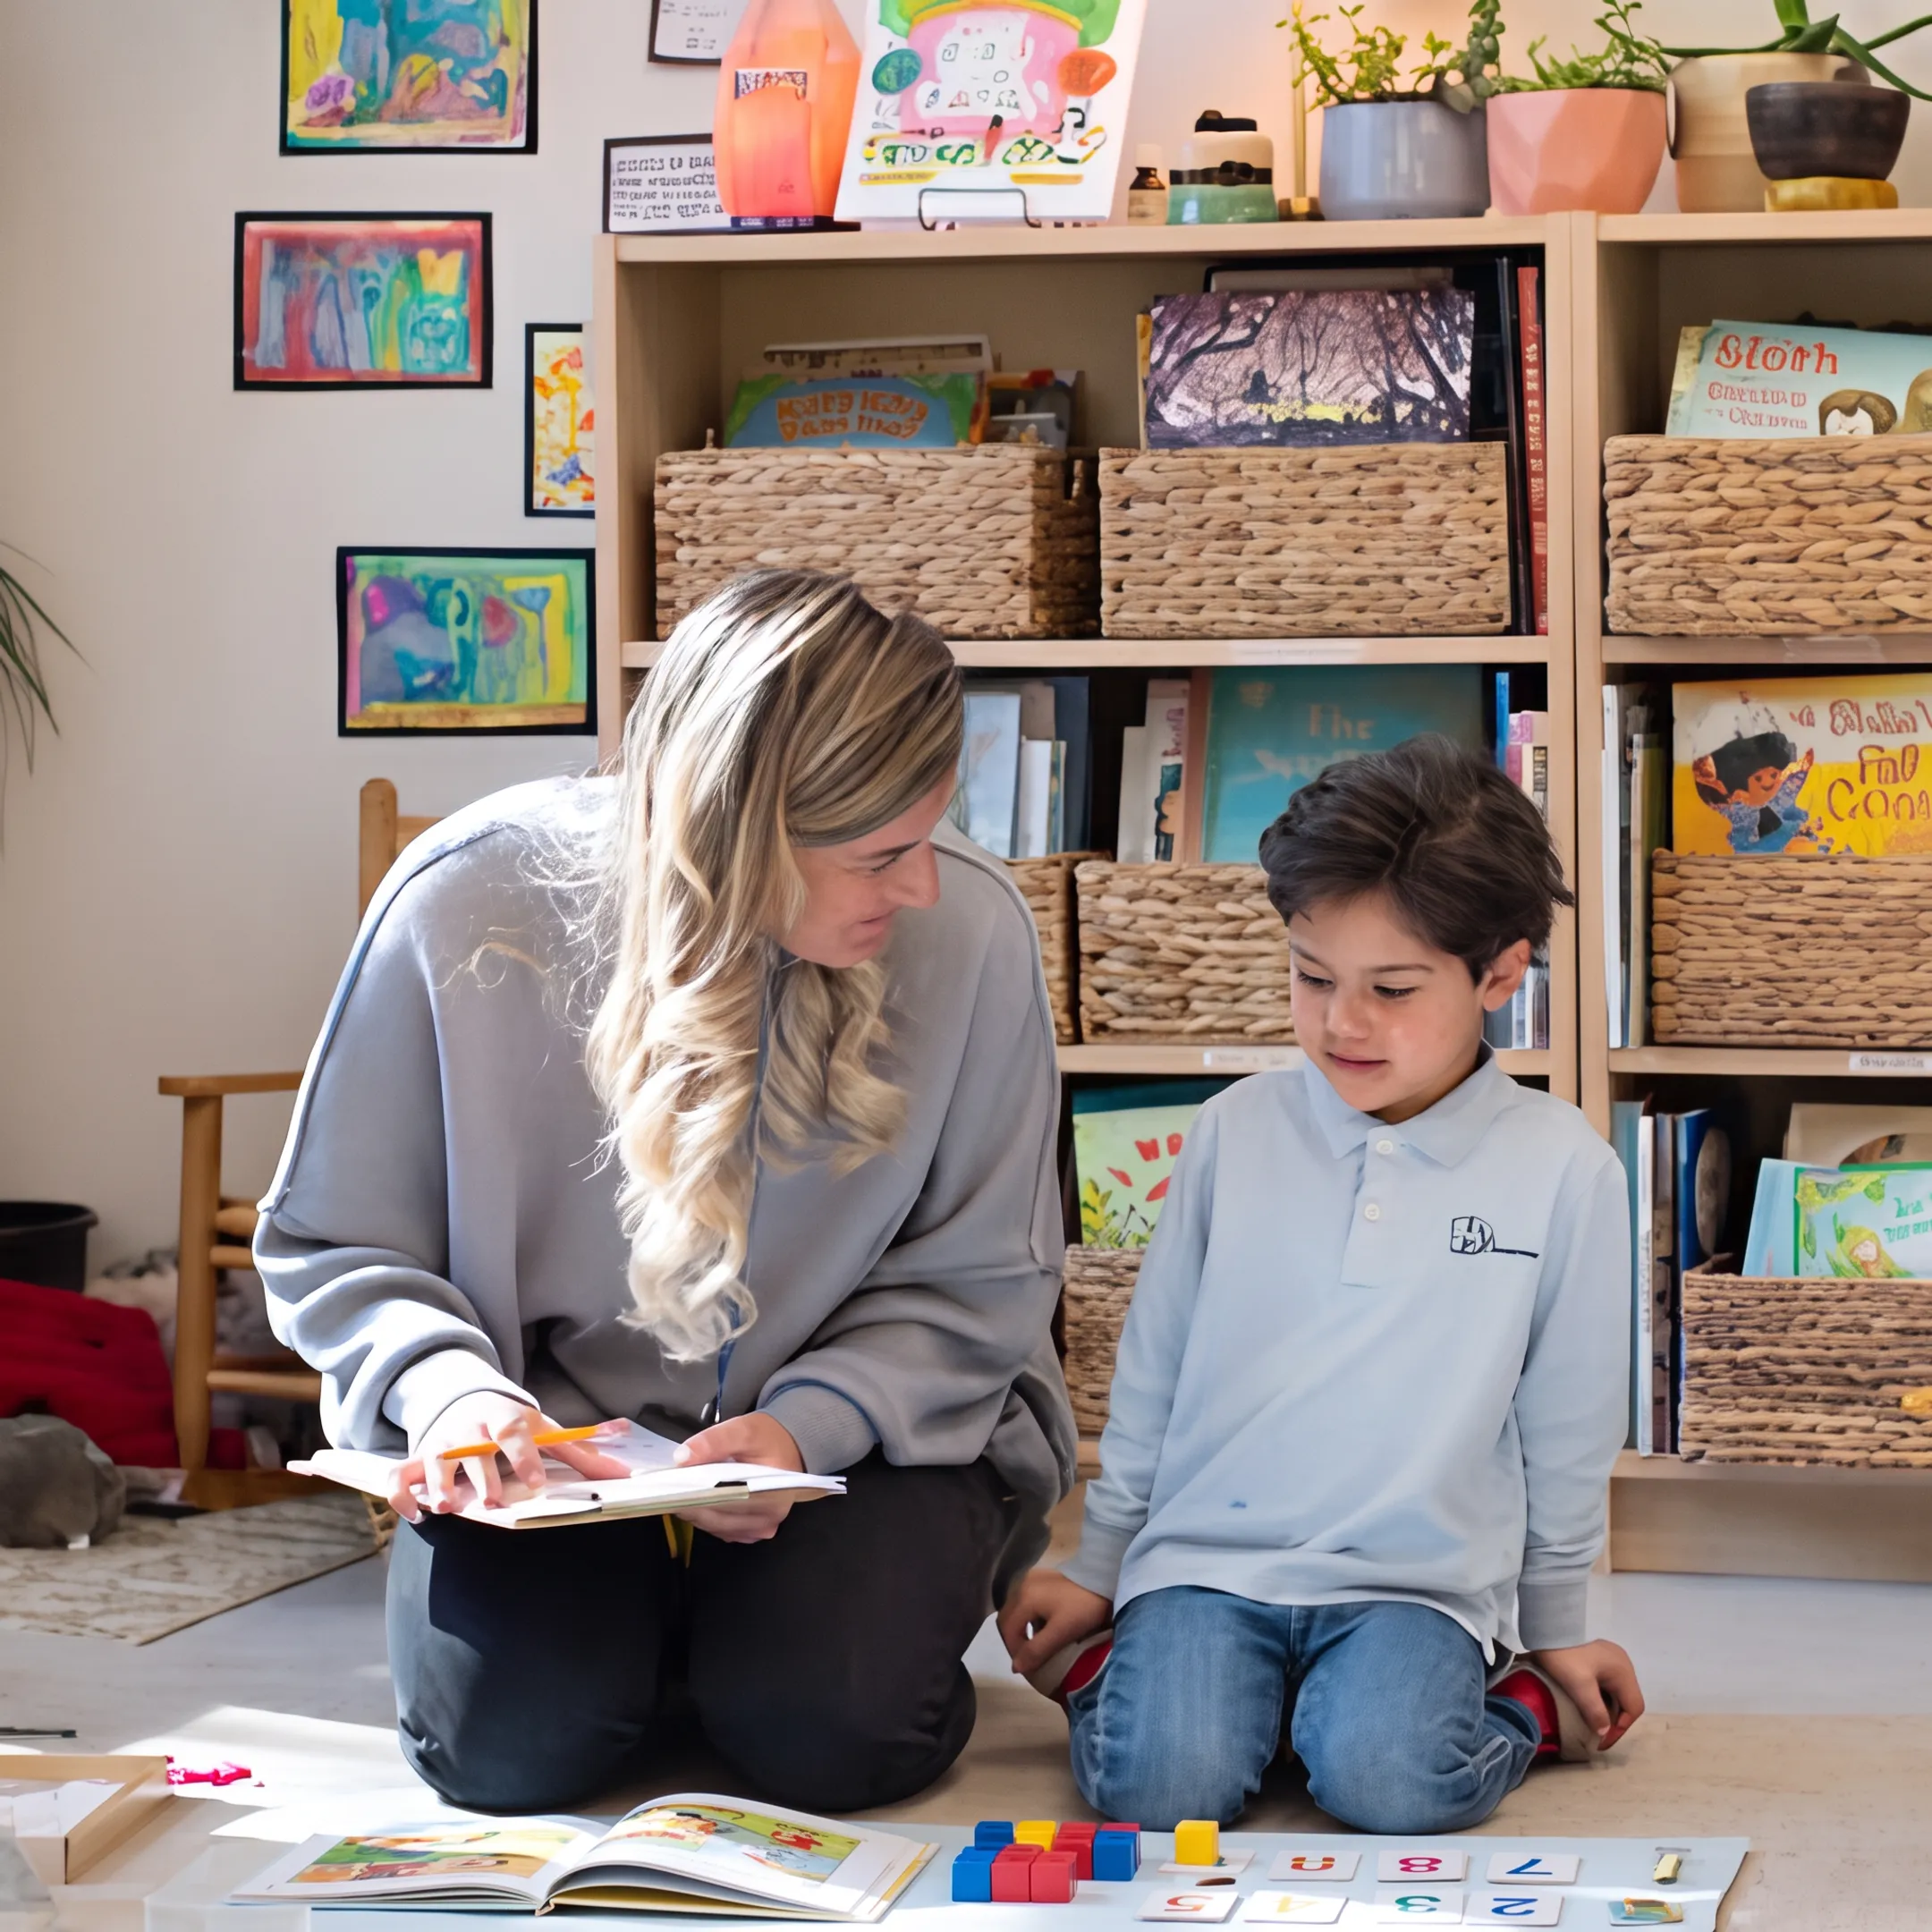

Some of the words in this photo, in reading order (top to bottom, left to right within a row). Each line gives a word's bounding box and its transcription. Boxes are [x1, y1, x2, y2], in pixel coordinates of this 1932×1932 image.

[1398, 1857, 1443, 1873] 8
[1505, 1858, 1554, 1875] 7
[1164, 1894, 1213, 1912] 5
[1272, 1895, 1319, 1913] 4
[1394, 1895, 1442, 1912] 3
[1491, 1897, 1539, 1916] 2
